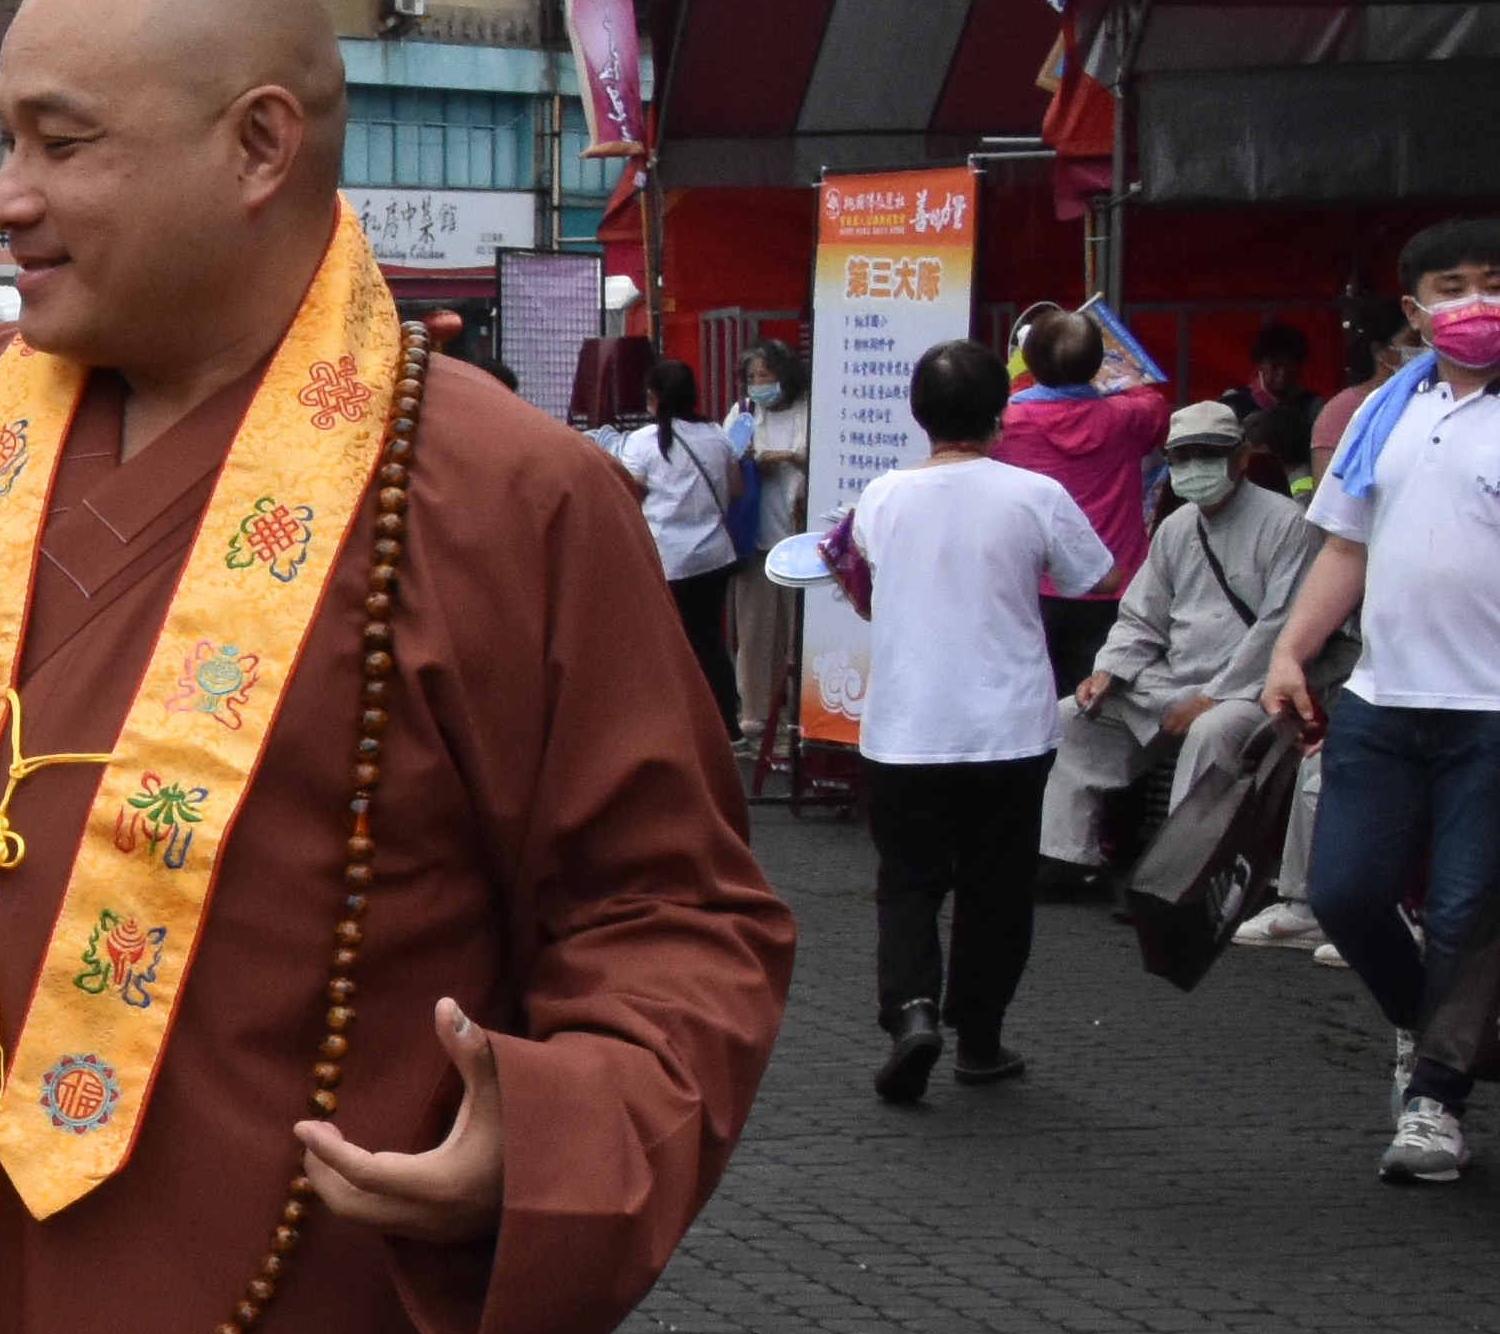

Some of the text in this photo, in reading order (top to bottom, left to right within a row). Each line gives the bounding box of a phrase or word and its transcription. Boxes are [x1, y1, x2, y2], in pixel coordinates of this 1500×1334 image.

[361, 195, 459, 244] 私房中菜館
[845, 254, 942, 301] 第三大隊
